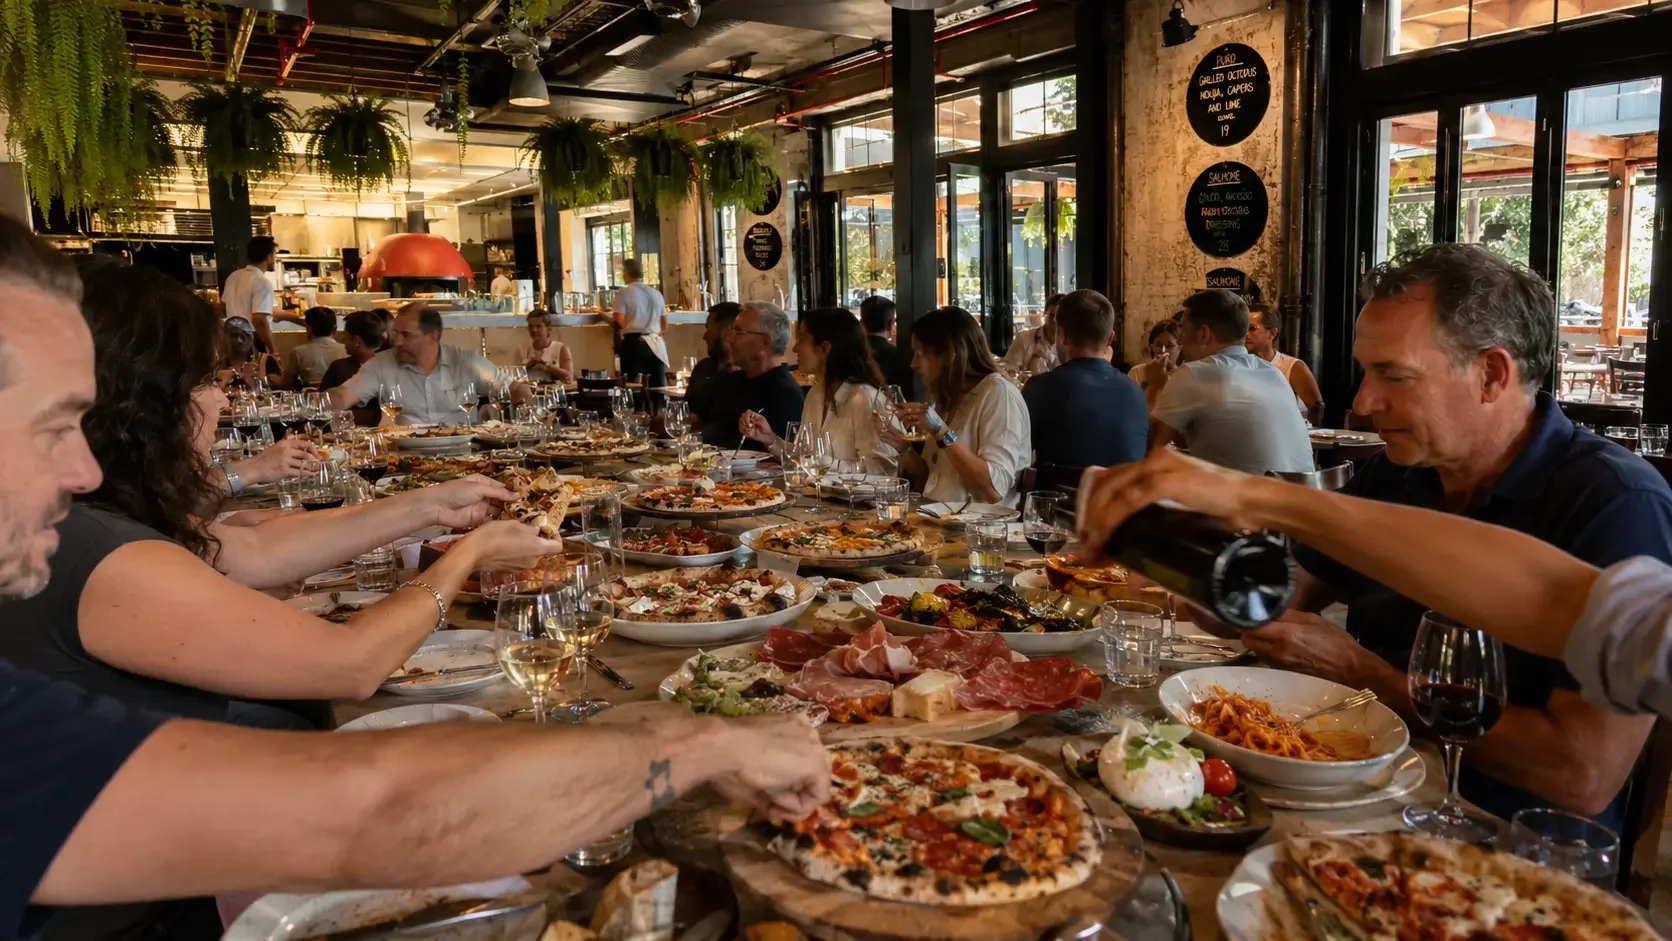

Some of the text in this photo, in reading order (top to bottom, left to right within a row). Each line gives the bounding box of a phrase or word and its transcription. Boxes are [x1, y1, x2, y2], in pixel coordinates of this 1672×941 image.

[1227, 82, 1254, 95] CAPERS
[1207, 102, 1222, 113] AND
[1221, 124, 1229, 137] 19
